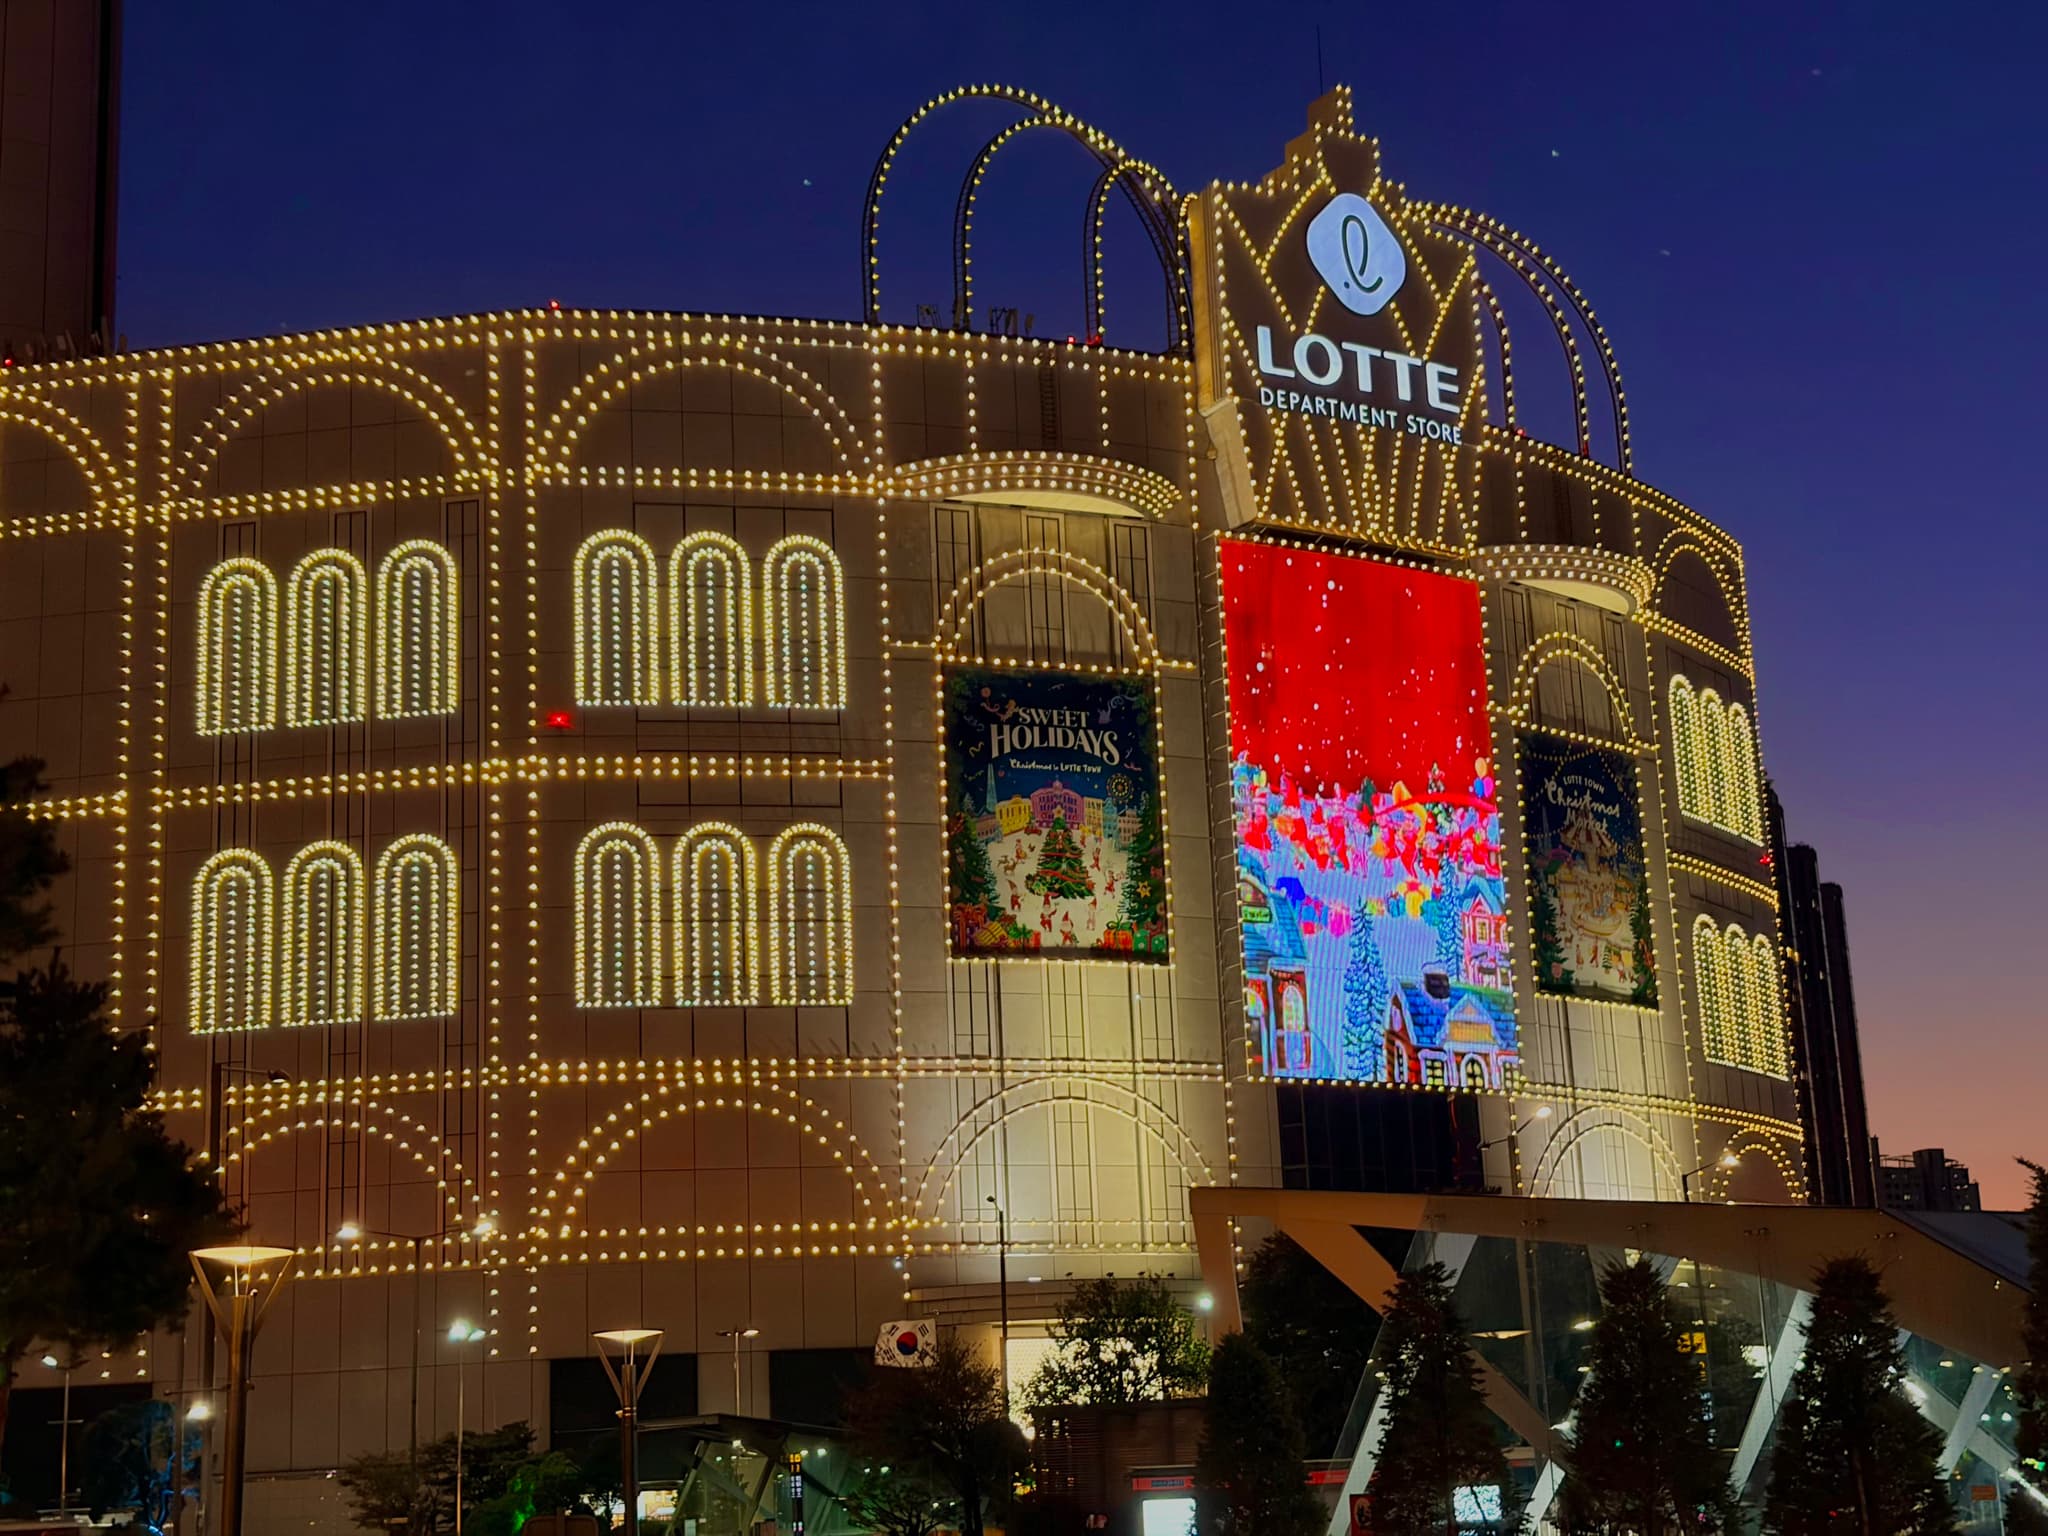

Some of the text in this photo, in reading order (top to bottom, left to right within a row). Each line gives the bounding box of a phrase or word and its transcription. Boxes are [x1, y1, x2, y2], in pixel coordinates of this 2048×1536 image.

[1256, 325, 1461, 414] LOTTE
[1260, 387, 1463, 446] DEPARTMENT STORE
[1018, 706, 1090, 728] SWEET
[989, 723, 1120, 766] HOLIDAYS
[1544, 776, 1620, 818] Christmas
[1584, 777, 1605, 795] TOWN
